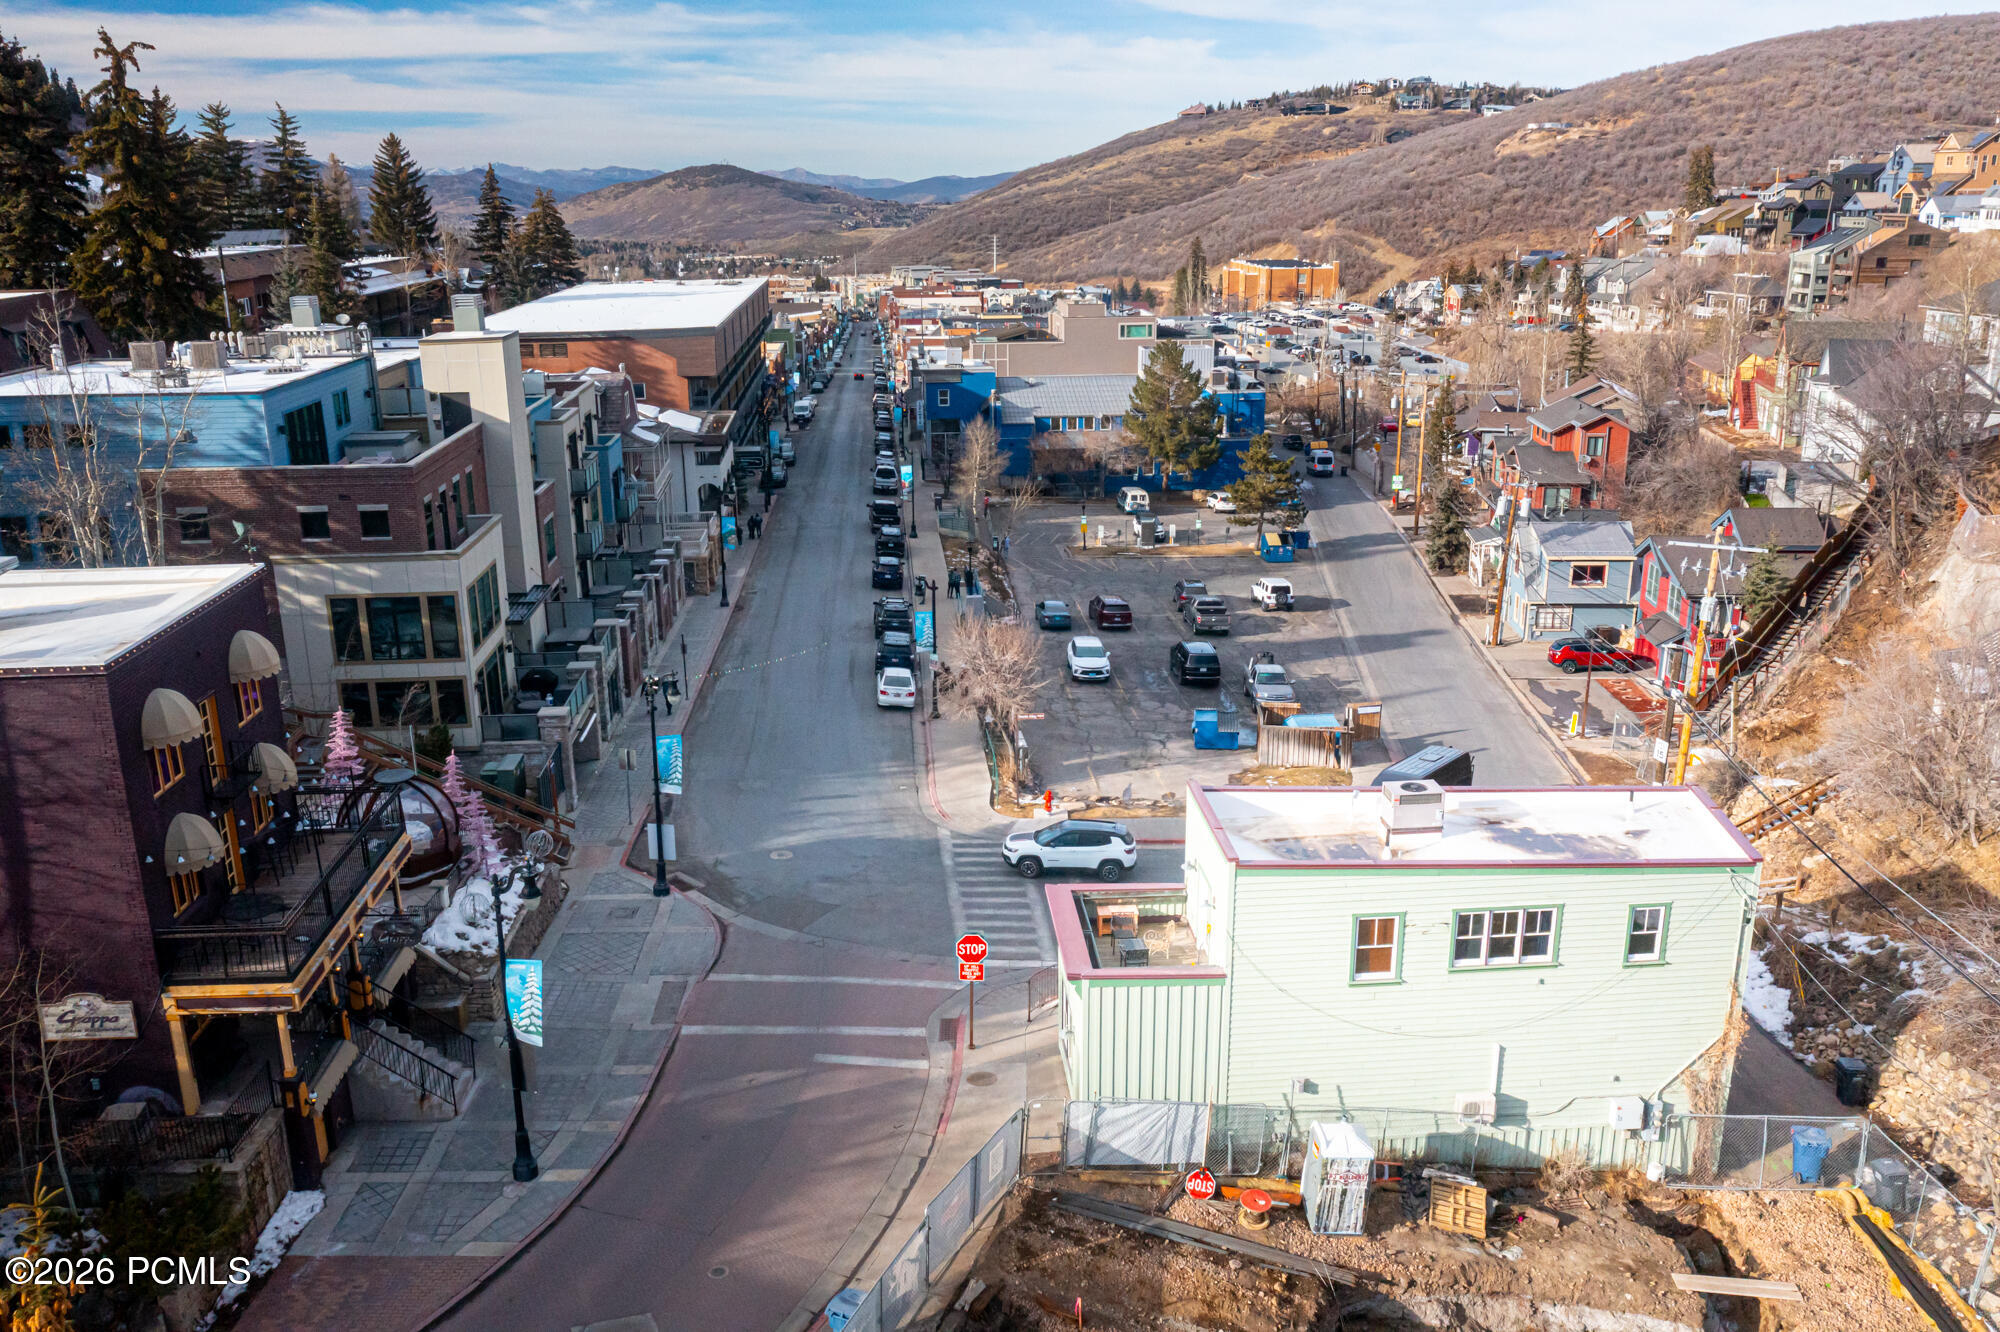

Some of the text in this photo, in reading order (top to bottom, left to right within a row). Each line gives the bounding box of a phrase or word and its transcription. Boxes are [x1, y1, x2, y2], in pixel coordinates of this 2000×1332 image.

[958, 943, 986, 955] STOP
[56, 1009, 120, 1028] Grappa
[1187, 1178, 1214, 1193] STOP
